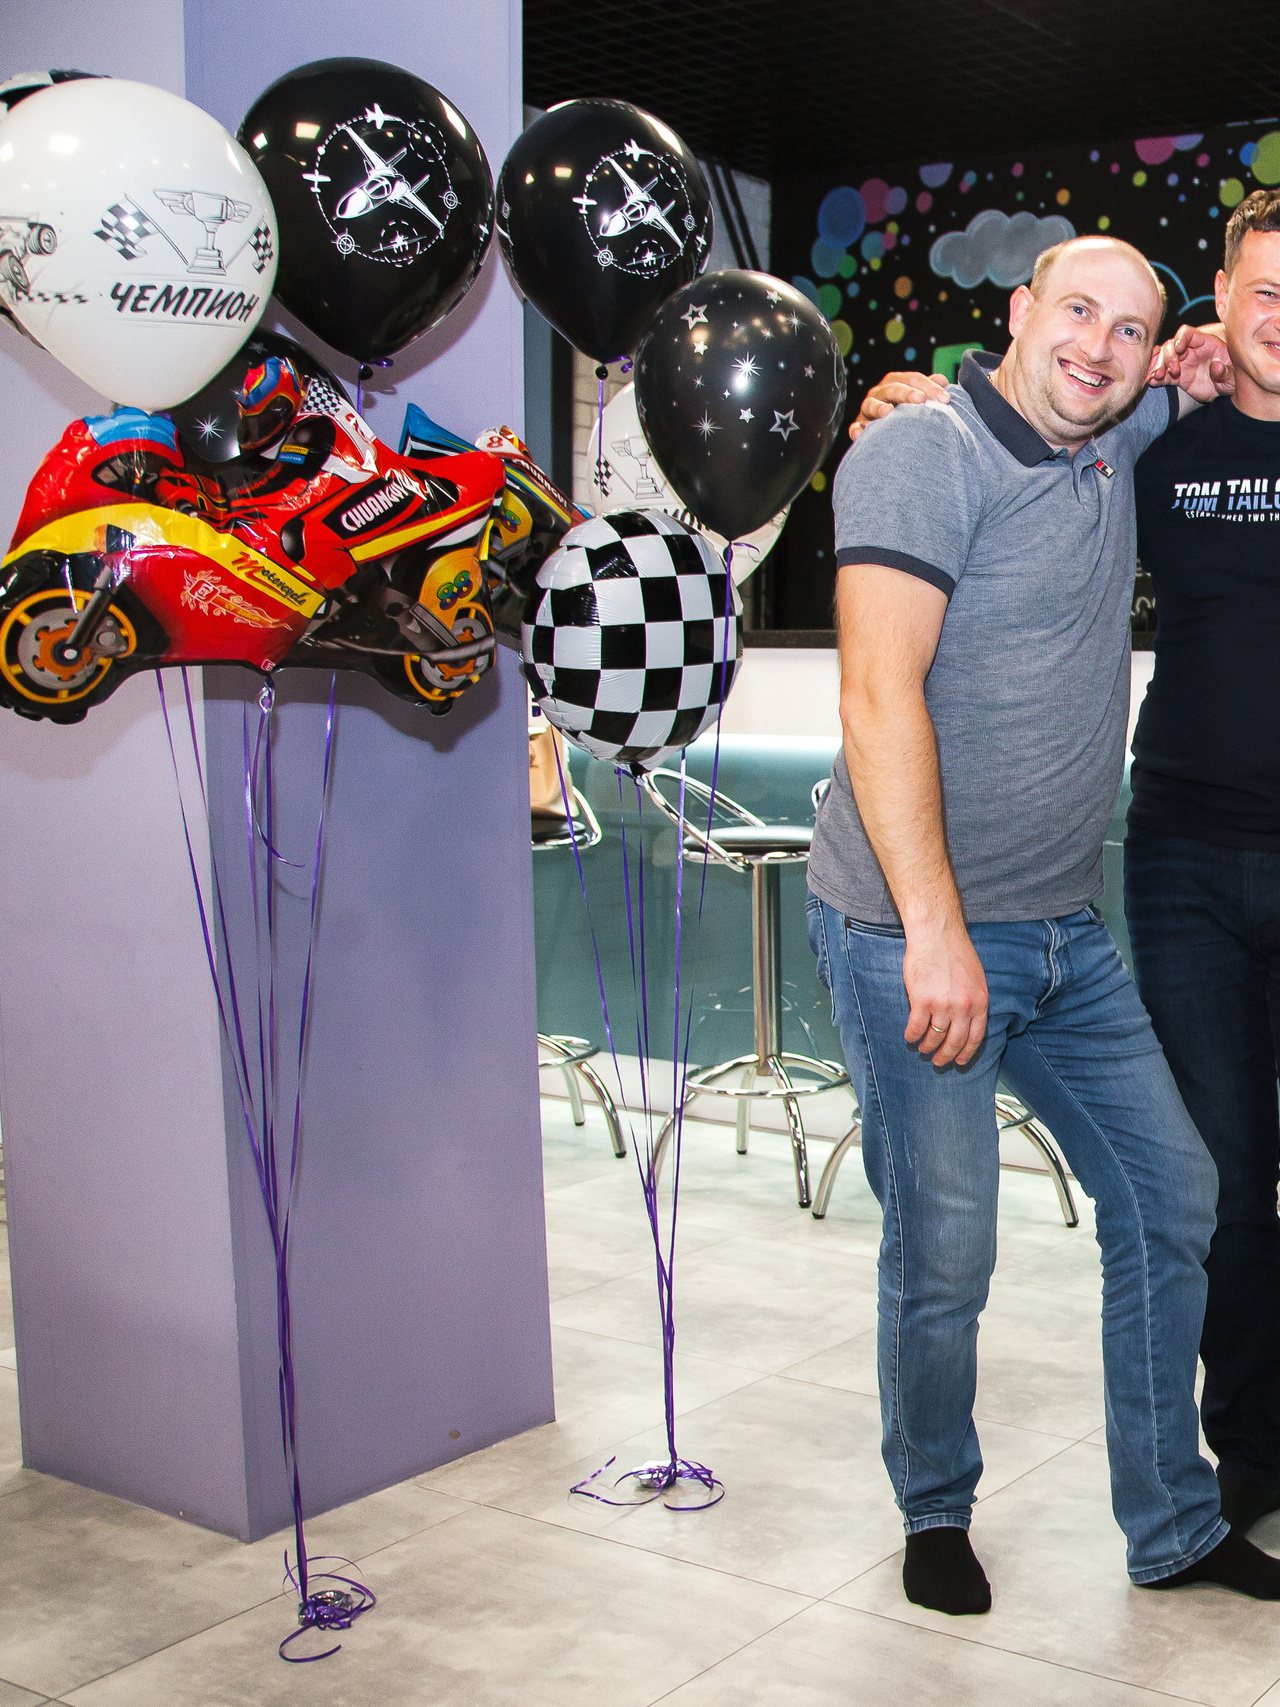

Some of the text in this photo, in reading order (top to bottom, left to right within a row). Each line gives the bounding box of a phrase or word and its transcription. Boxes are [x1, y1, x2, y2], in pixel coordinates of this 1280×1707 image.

[110, 281, 260, 323] ЧЕМПИОН
[1171, 481, 1221, 512] TOM
[1248, 513, 1265, 523] TWO
[231, 551, 307, 608] Motorcycle
[436, 569, 474, 611] 88
